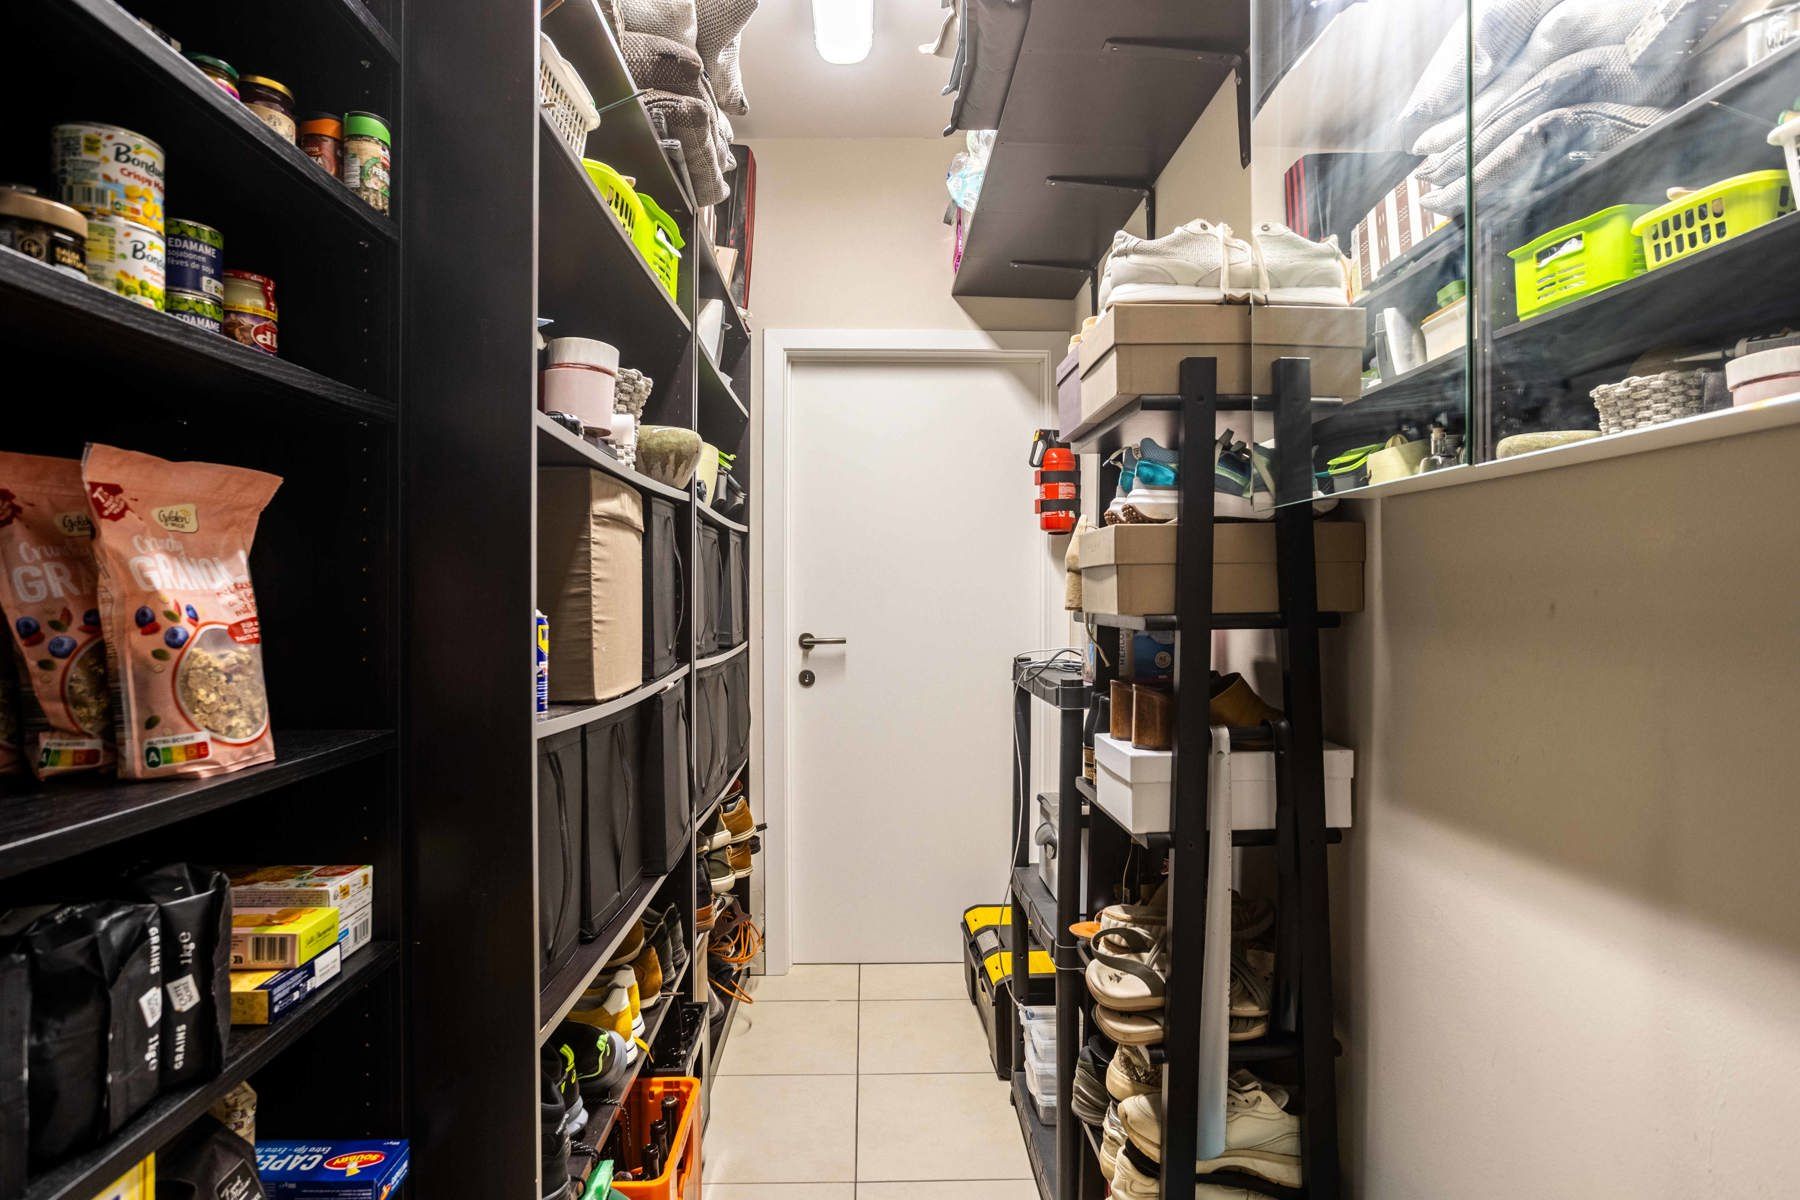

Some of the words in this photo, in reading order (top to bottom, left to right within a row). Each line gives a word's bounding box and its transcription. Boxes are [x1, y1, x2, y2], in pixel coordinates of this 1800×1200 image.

[167, 237, 217, 259] EDAMAME
[148, 926, 161, 975] GRAINS
[173, 1023, 187, 1070] GRAINS
